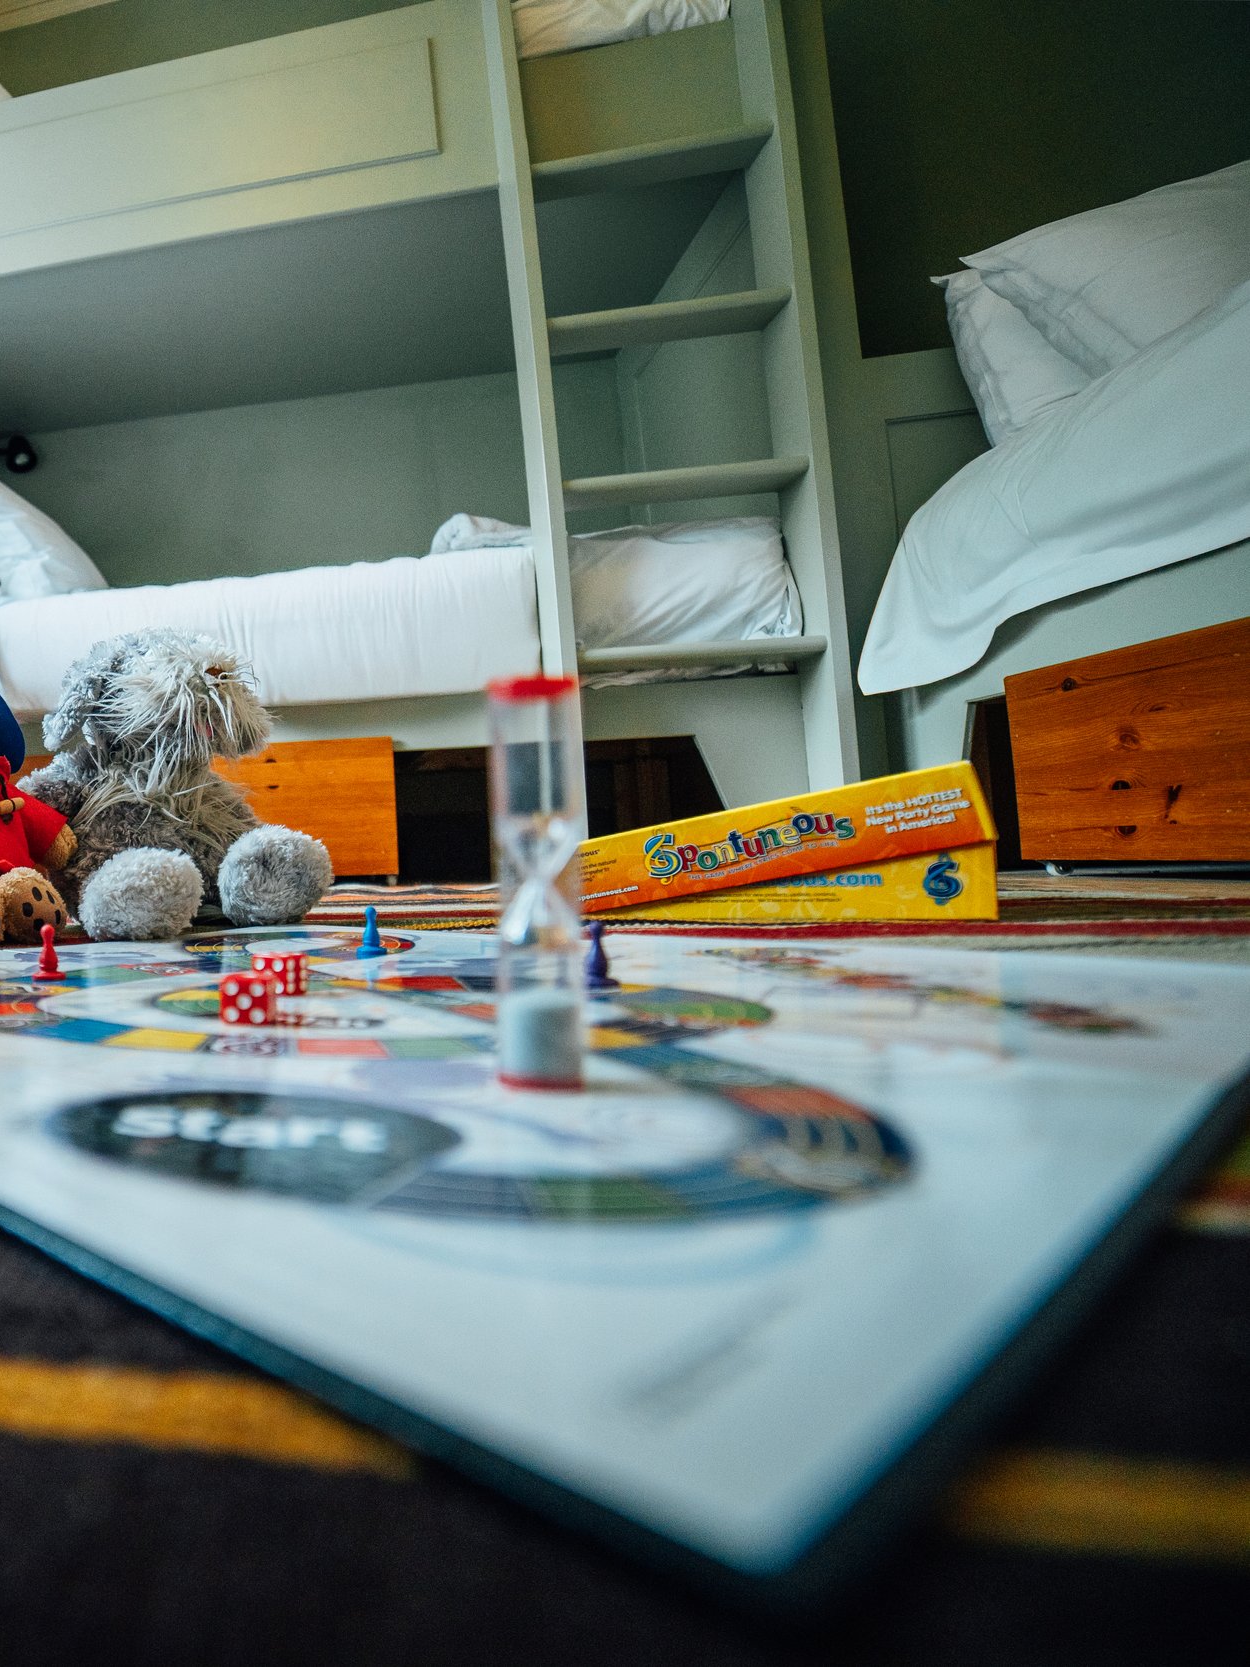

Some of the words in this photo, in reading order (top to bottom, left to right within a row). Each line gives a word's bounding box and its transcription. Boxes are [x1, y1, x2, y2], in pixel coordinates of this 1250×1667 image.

[884, 801, 905, 812] the
[906, 788, 962, 807] HOTTEST
[866, 815, 894, 826] New
[895, 808, 929, 821] Party
[931, 800, 971, 814] Game
[885, 823, 898, 834] in
[899, 812, 956, 831] America!
